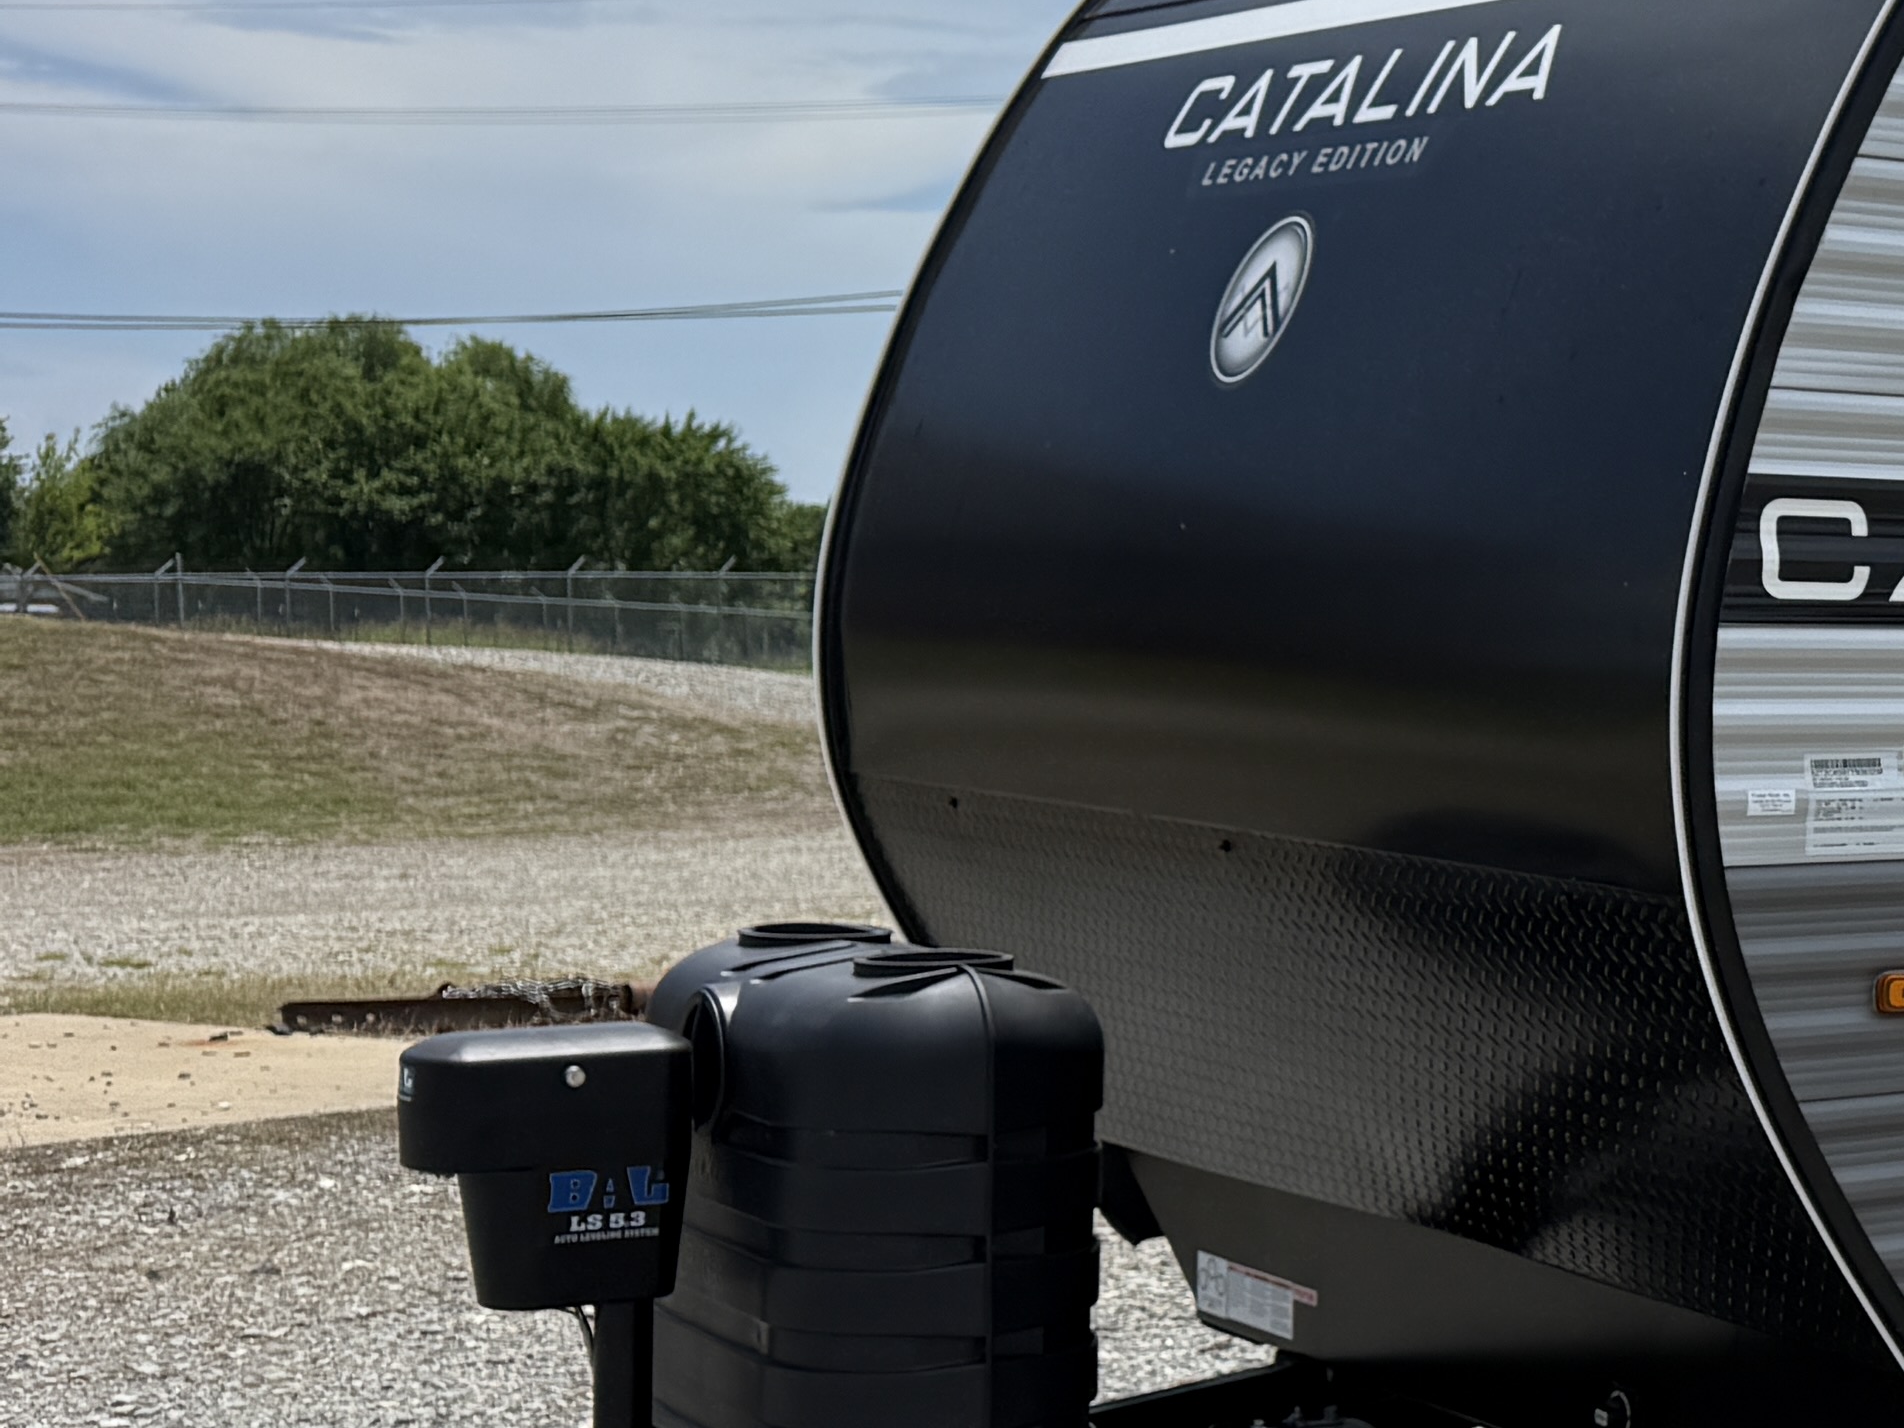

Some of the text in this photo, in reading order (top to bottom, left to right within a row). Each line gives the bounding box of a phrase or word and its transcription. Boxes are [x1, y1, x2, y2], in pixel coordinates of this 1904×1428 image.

[1164, 24, 1562, 149] CATALINA
[1201, 136, 1429, 186] LEGACY EDITION
[569, 1213, 604, 1232] LS
